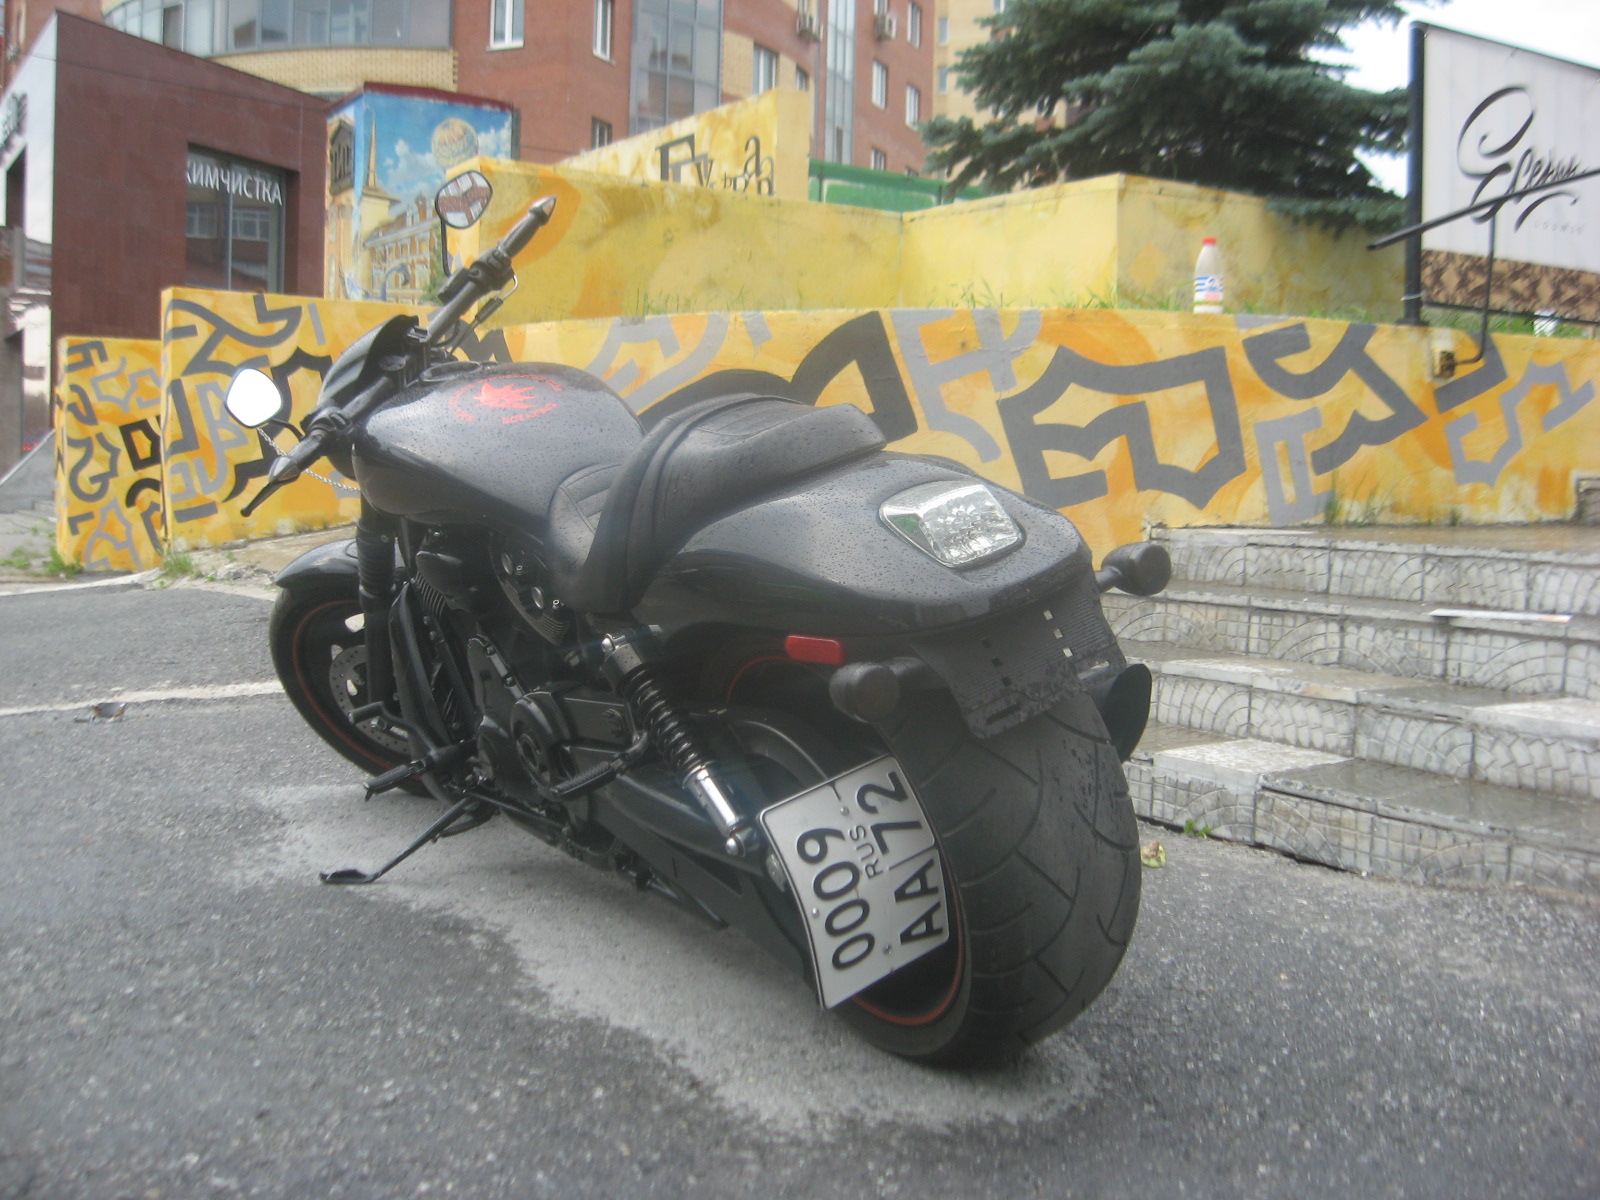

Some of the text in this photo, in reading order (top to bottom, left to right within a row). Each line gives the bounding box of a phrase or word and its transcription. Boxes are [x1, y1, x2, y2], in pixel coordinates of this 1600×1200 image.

[797, 827, 875, 971] 0009
[849, 825, 883, 880] RUS
[856, 770, 944, 945] AA 72
